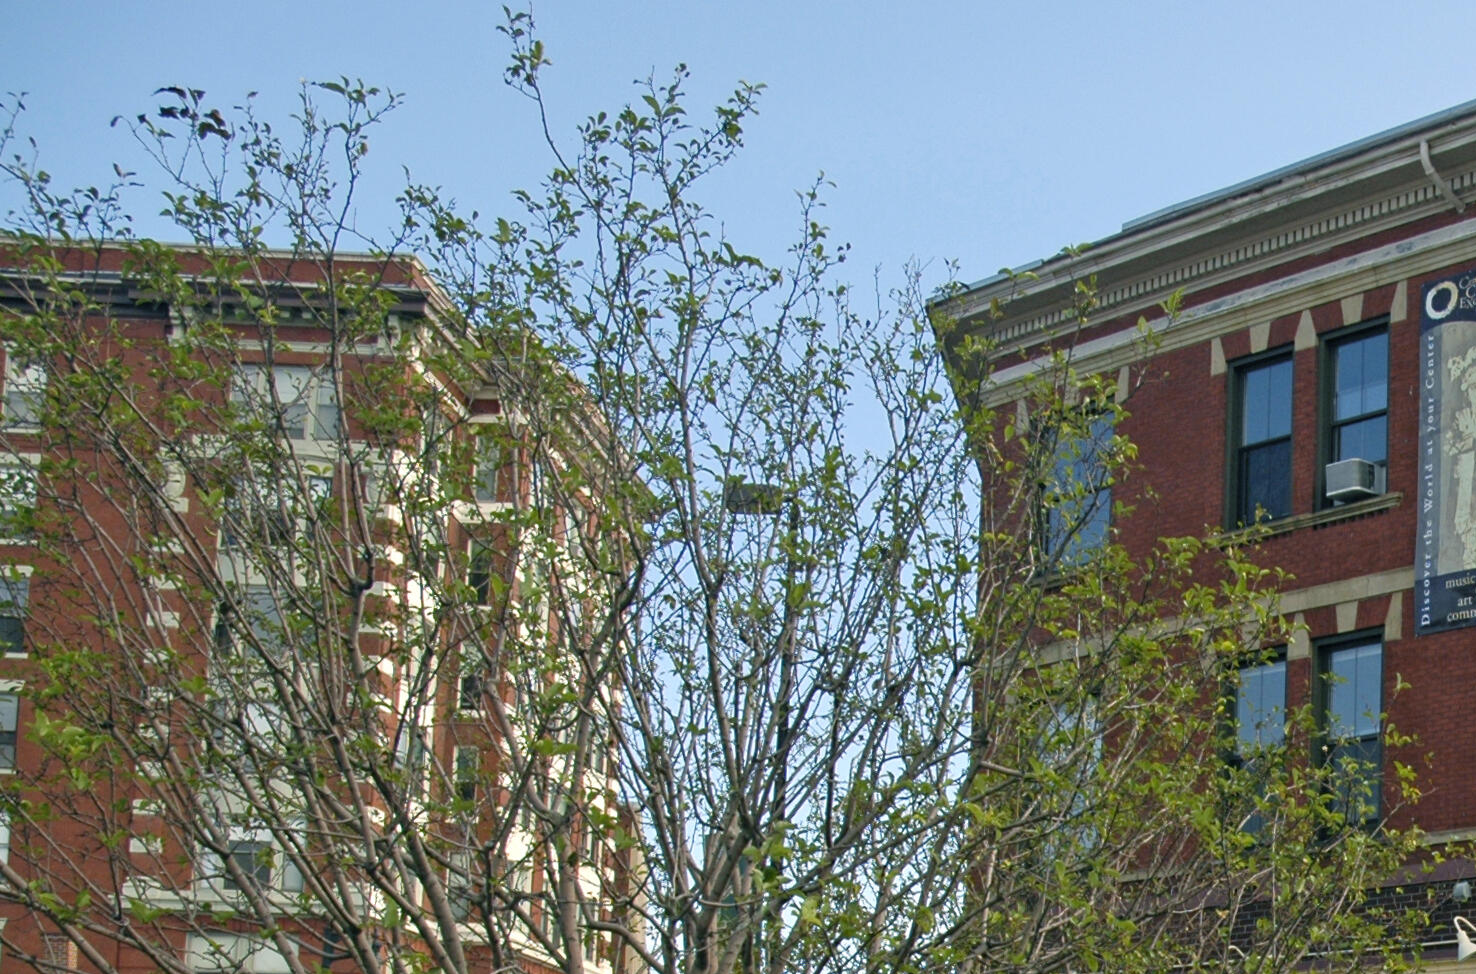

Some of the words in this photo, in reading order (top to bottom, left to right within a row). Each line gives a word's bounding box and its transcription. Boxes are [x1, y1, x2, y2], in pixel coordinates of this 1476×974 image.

[1425, 335, 1435, 389] Center
[1426, 398, 1436, 432] your
[1424, 463, 1434, 513] World
[1424, 519, 1433, 545] the
[1421, 554, 1431, 626] Discover
[1445, 572, 1476, 589] music
[1457, 596, 1473, 607] art
